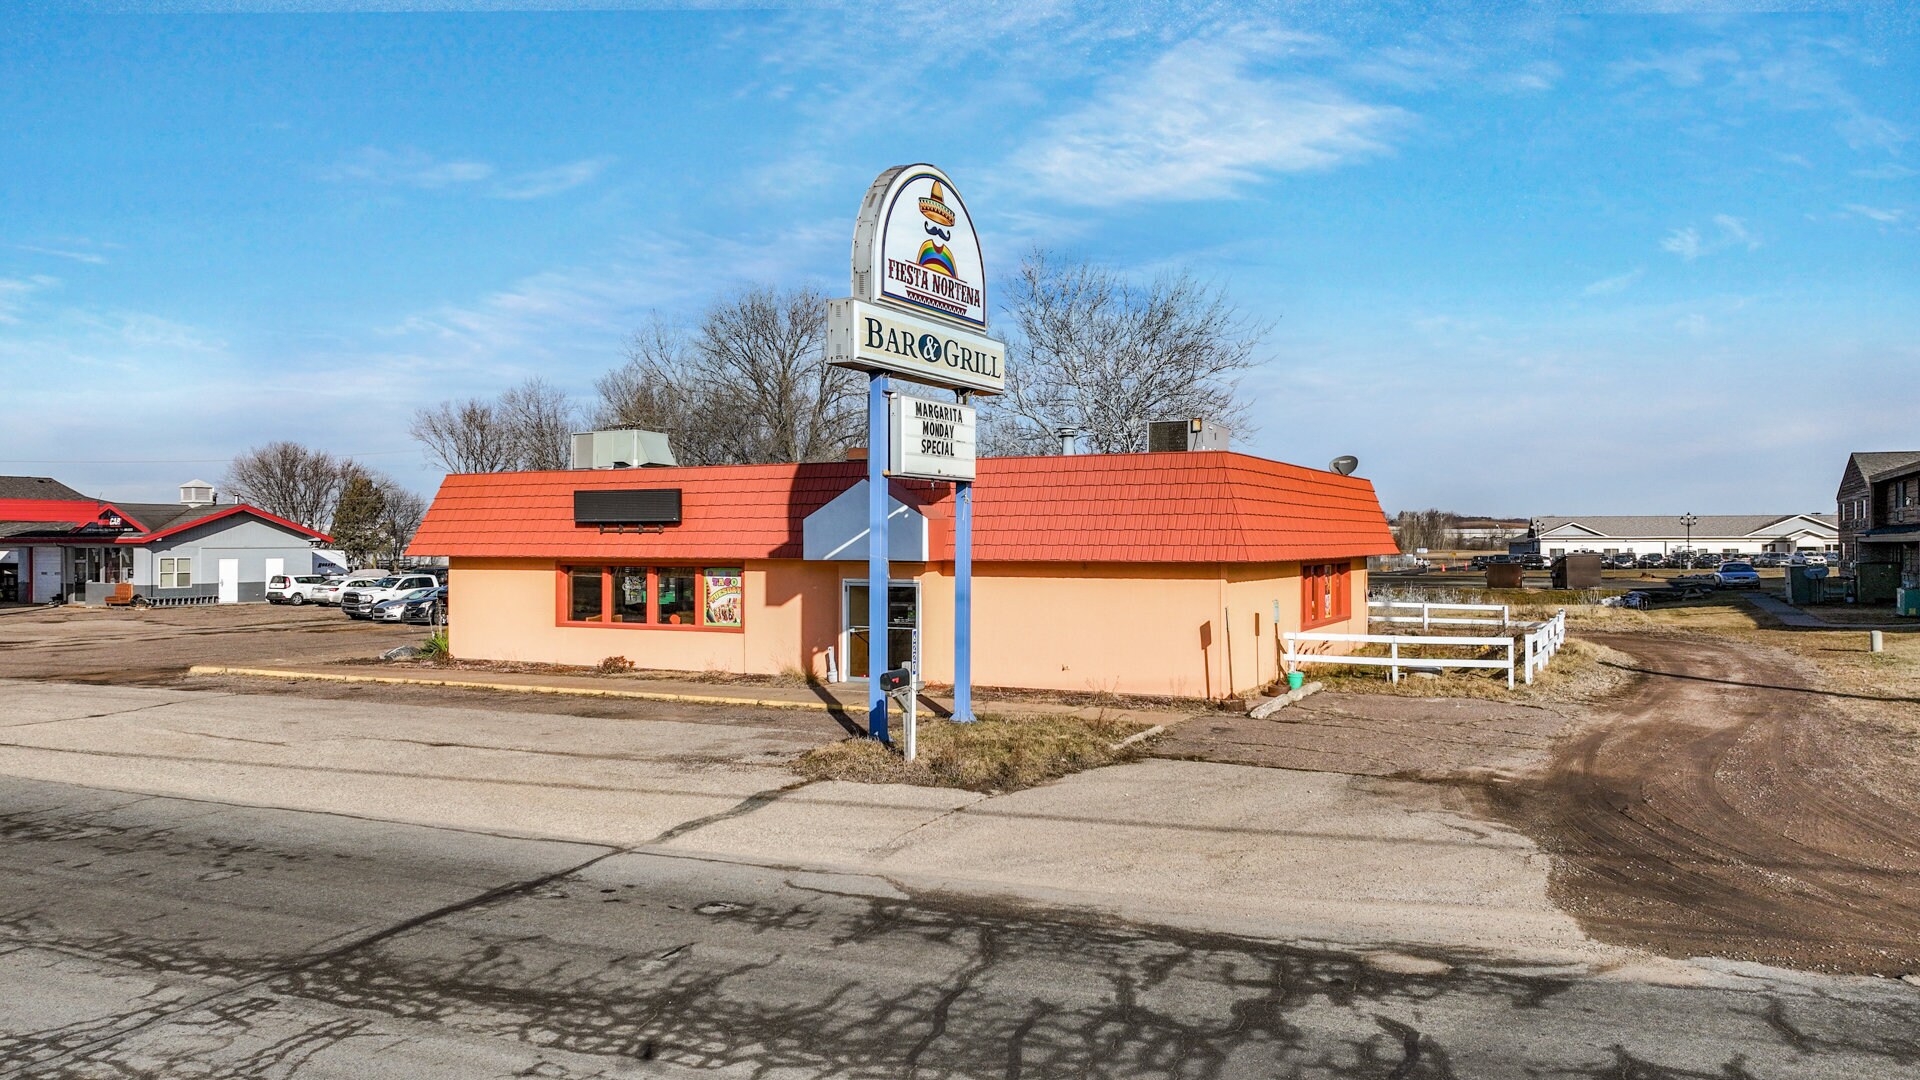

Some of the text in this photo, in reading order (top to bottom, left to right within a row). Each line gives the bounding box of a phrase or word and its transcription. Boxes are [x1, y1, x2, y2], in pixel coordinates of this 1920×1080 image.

[888, 258, 981, 308] FIESTA NORTENA
[864, 317, 1002, 379] BAR & GRILL
[915, 401, 963, 424] MARGARITA
[922, 420, 955, 439] MONDAY
[921, 439, 955, 457] SPECIAL
[712, 577, 738, 586] TACO
[709, 586, 742, 603] TUESDAY
